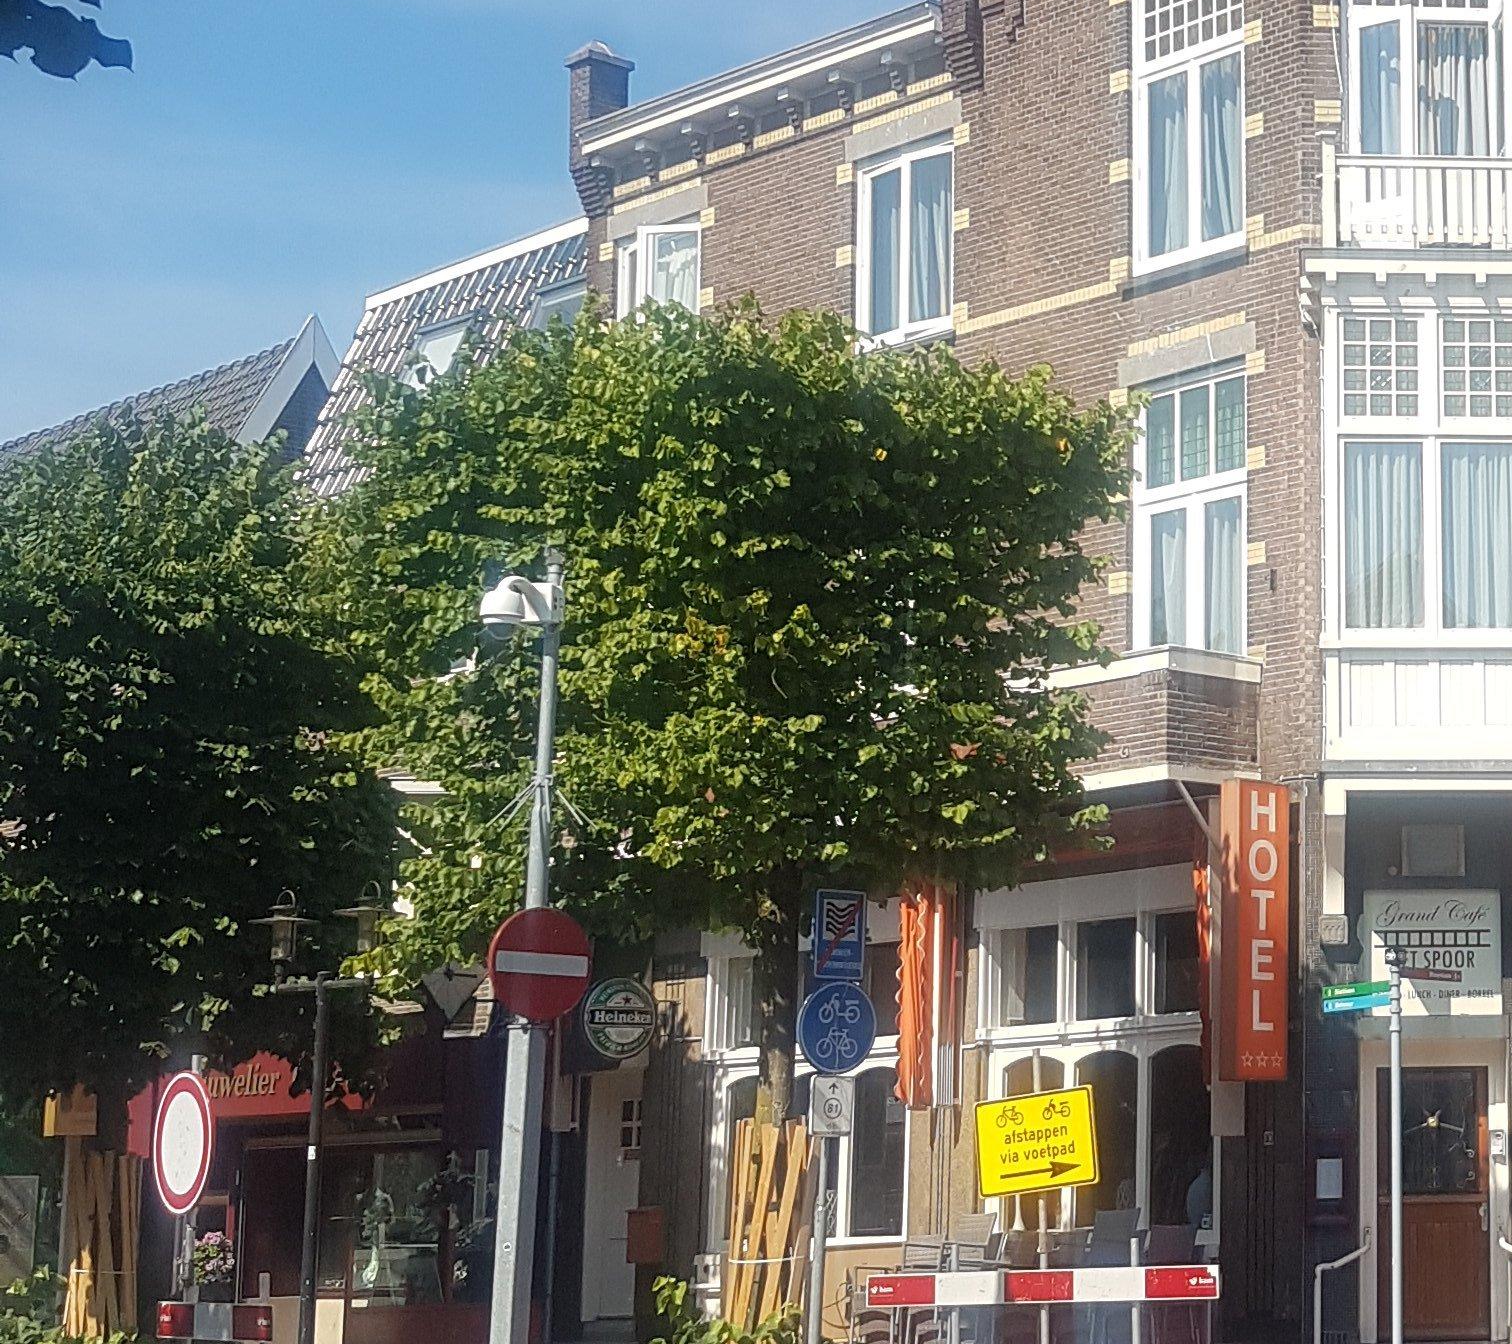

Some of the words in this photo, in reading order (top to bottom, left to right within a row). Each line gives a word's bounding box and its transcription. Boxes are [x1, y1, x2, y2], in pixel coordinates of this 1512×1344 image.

[1248, 790, 1278, 1032] HOTEL
[1375, 899, 1441, 928] Grand
[1443, 899, 1491, 928] Café
[1423, 950, 1476, 968] SPOOR
[206, 1062, 281, 1098] uwelier
[1004, 1125, 1068, 1145] afstappen
[1000, 1149, 1019, 1164] via
[1023, 1140, 1076, 1159] voetpad
